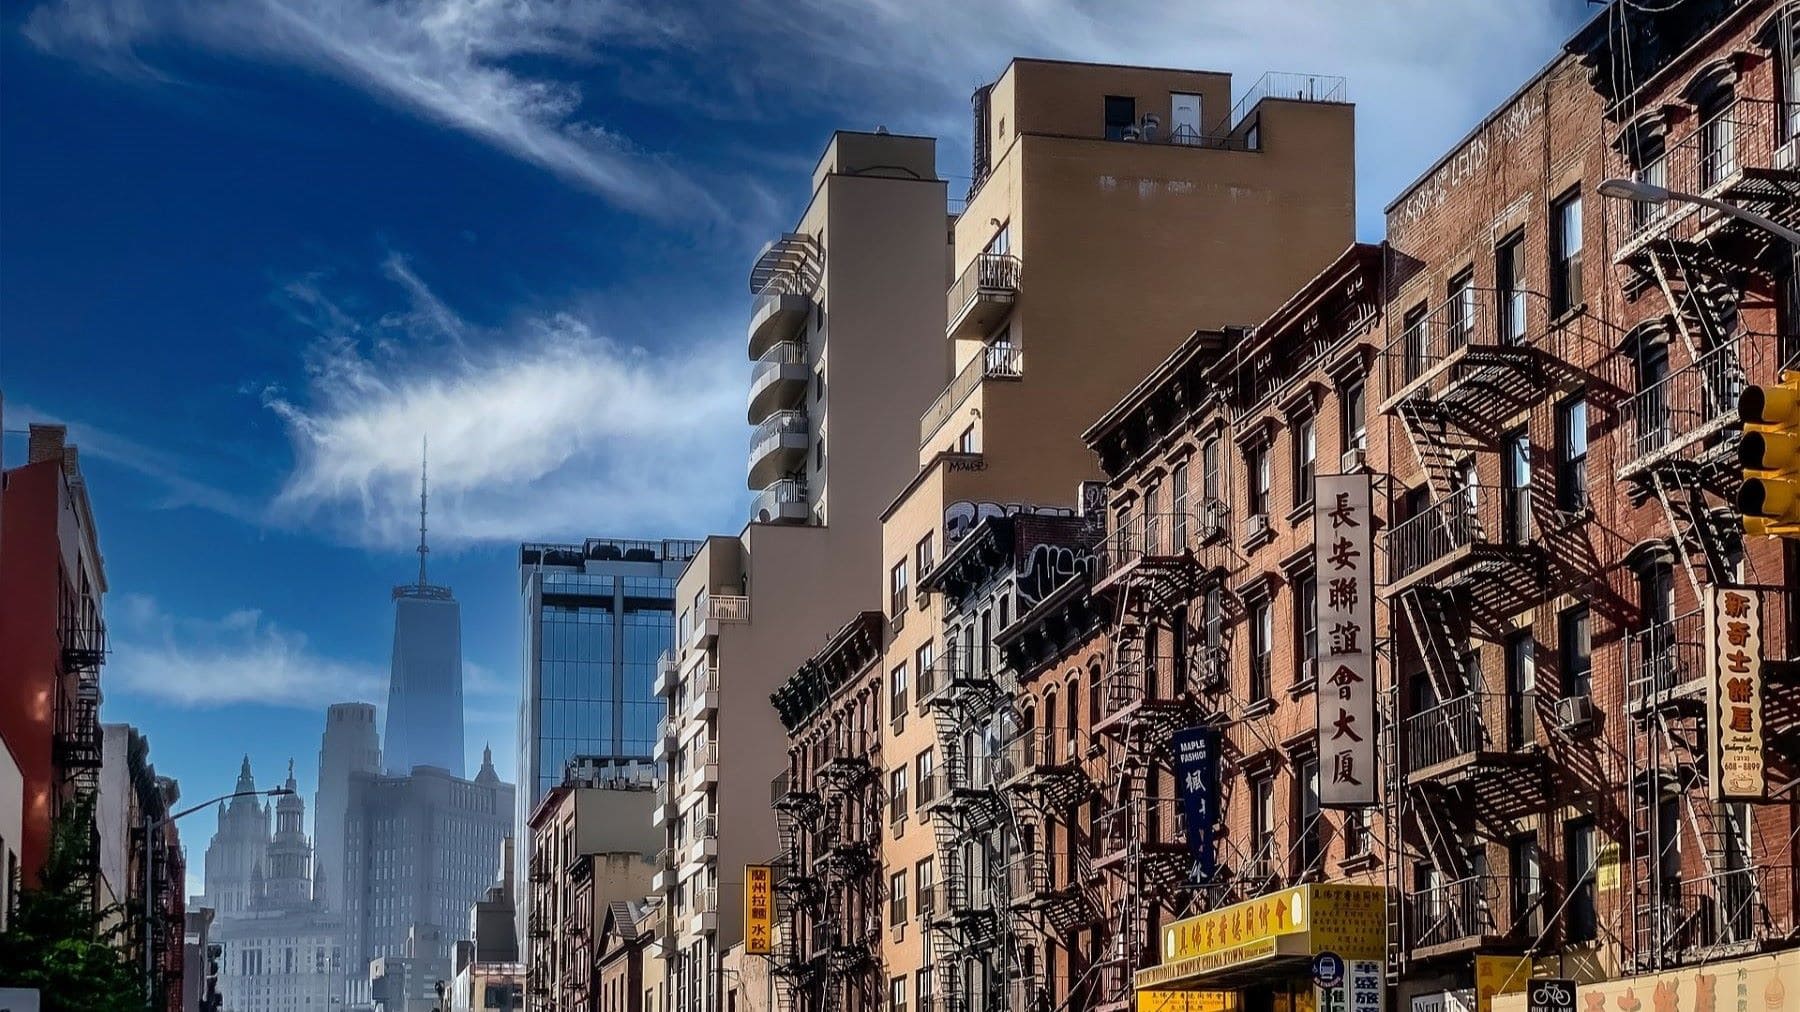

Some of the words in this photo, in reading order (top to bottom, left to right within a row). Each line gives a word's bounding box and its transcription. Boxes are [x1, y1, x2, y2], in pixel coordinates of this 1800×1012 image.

[1327, 492, 1363, 787] 長安聯誼會大廈
[1724, 591, 1754, 734] 新奇士餅屋
[1180, 739, 1206, 752] MAPLE
